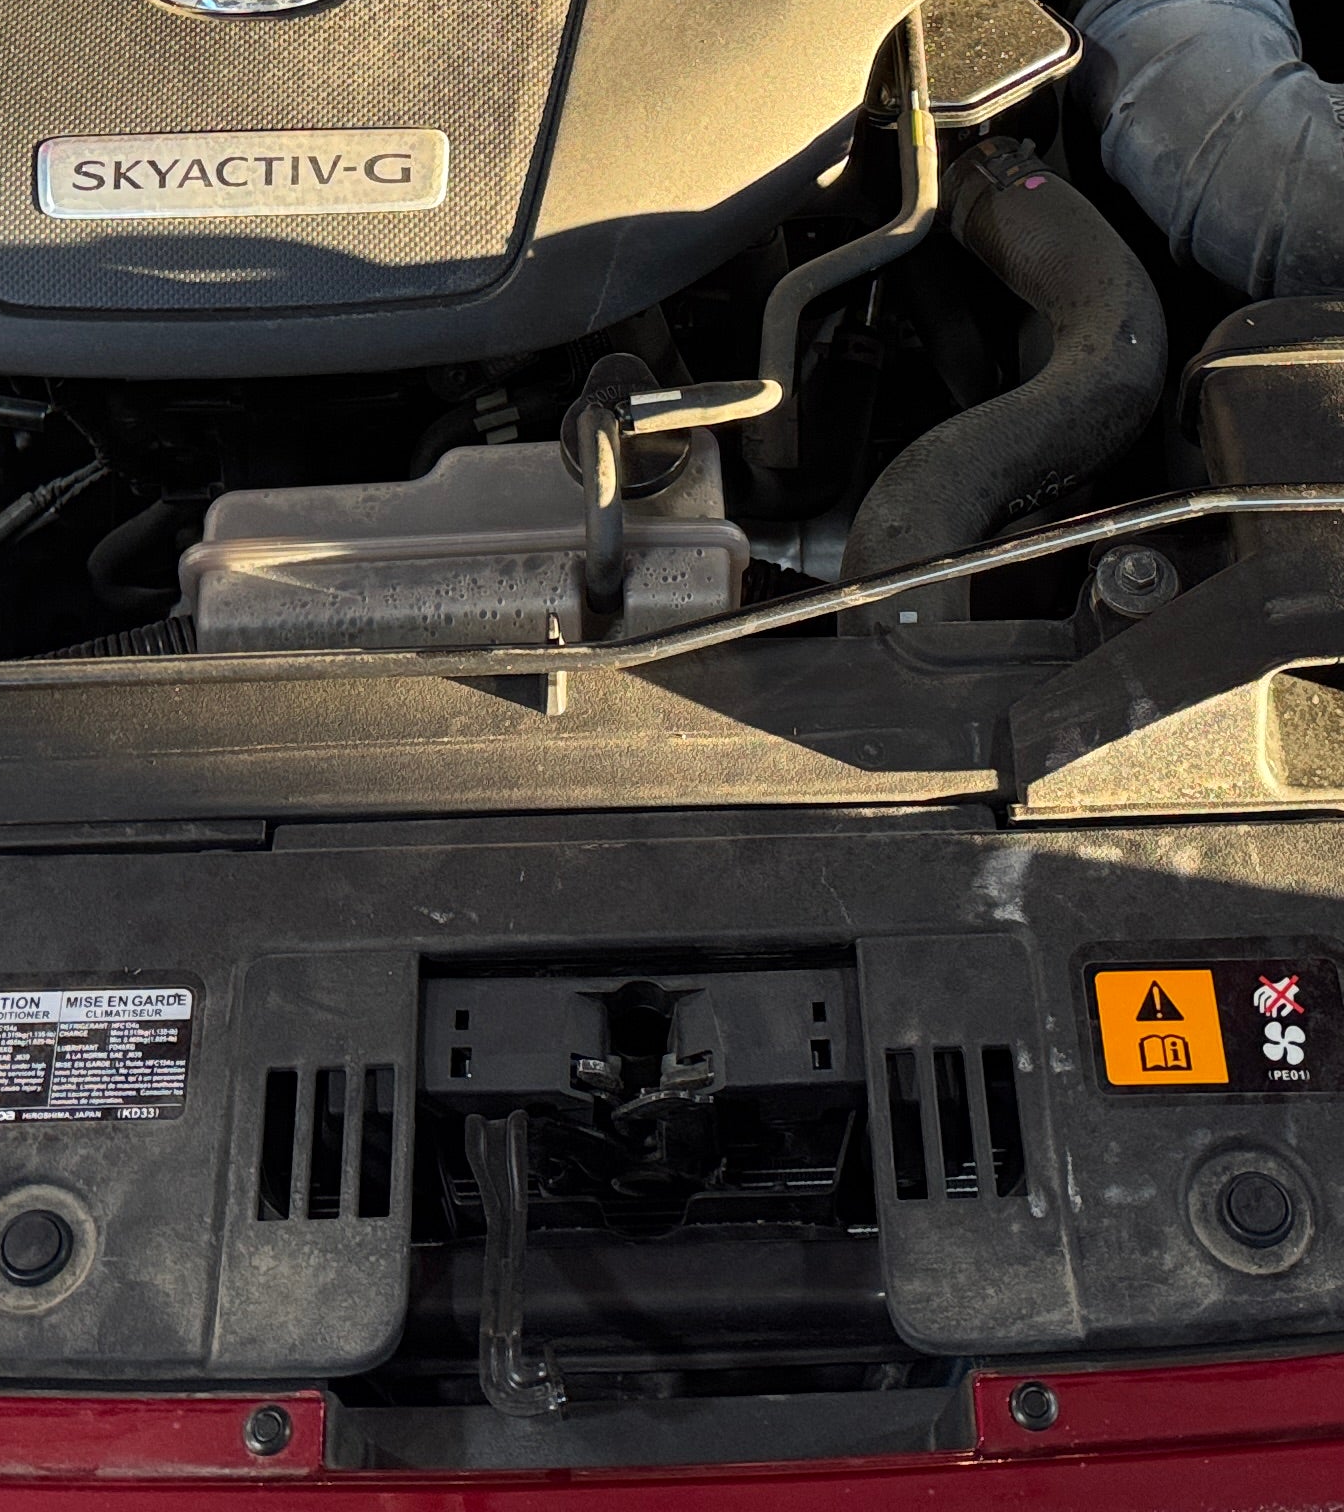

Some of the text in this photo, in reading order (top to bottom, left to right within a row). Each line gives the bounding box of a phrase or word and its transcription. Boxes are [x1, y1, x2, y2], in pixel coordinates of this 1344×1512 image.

[70, 152, 413, 191] SKYACTIV-G
[65, 993, 187, 1009] MISE EN GARDE
[85, 1008, 163, 1019] CLIMATISEUR
[1268, 1069, 1311, 1081] (PE01)
[74, 1110, 102, 1119] JAPAN
[117, 1107, 160, 1119] (KD33)
